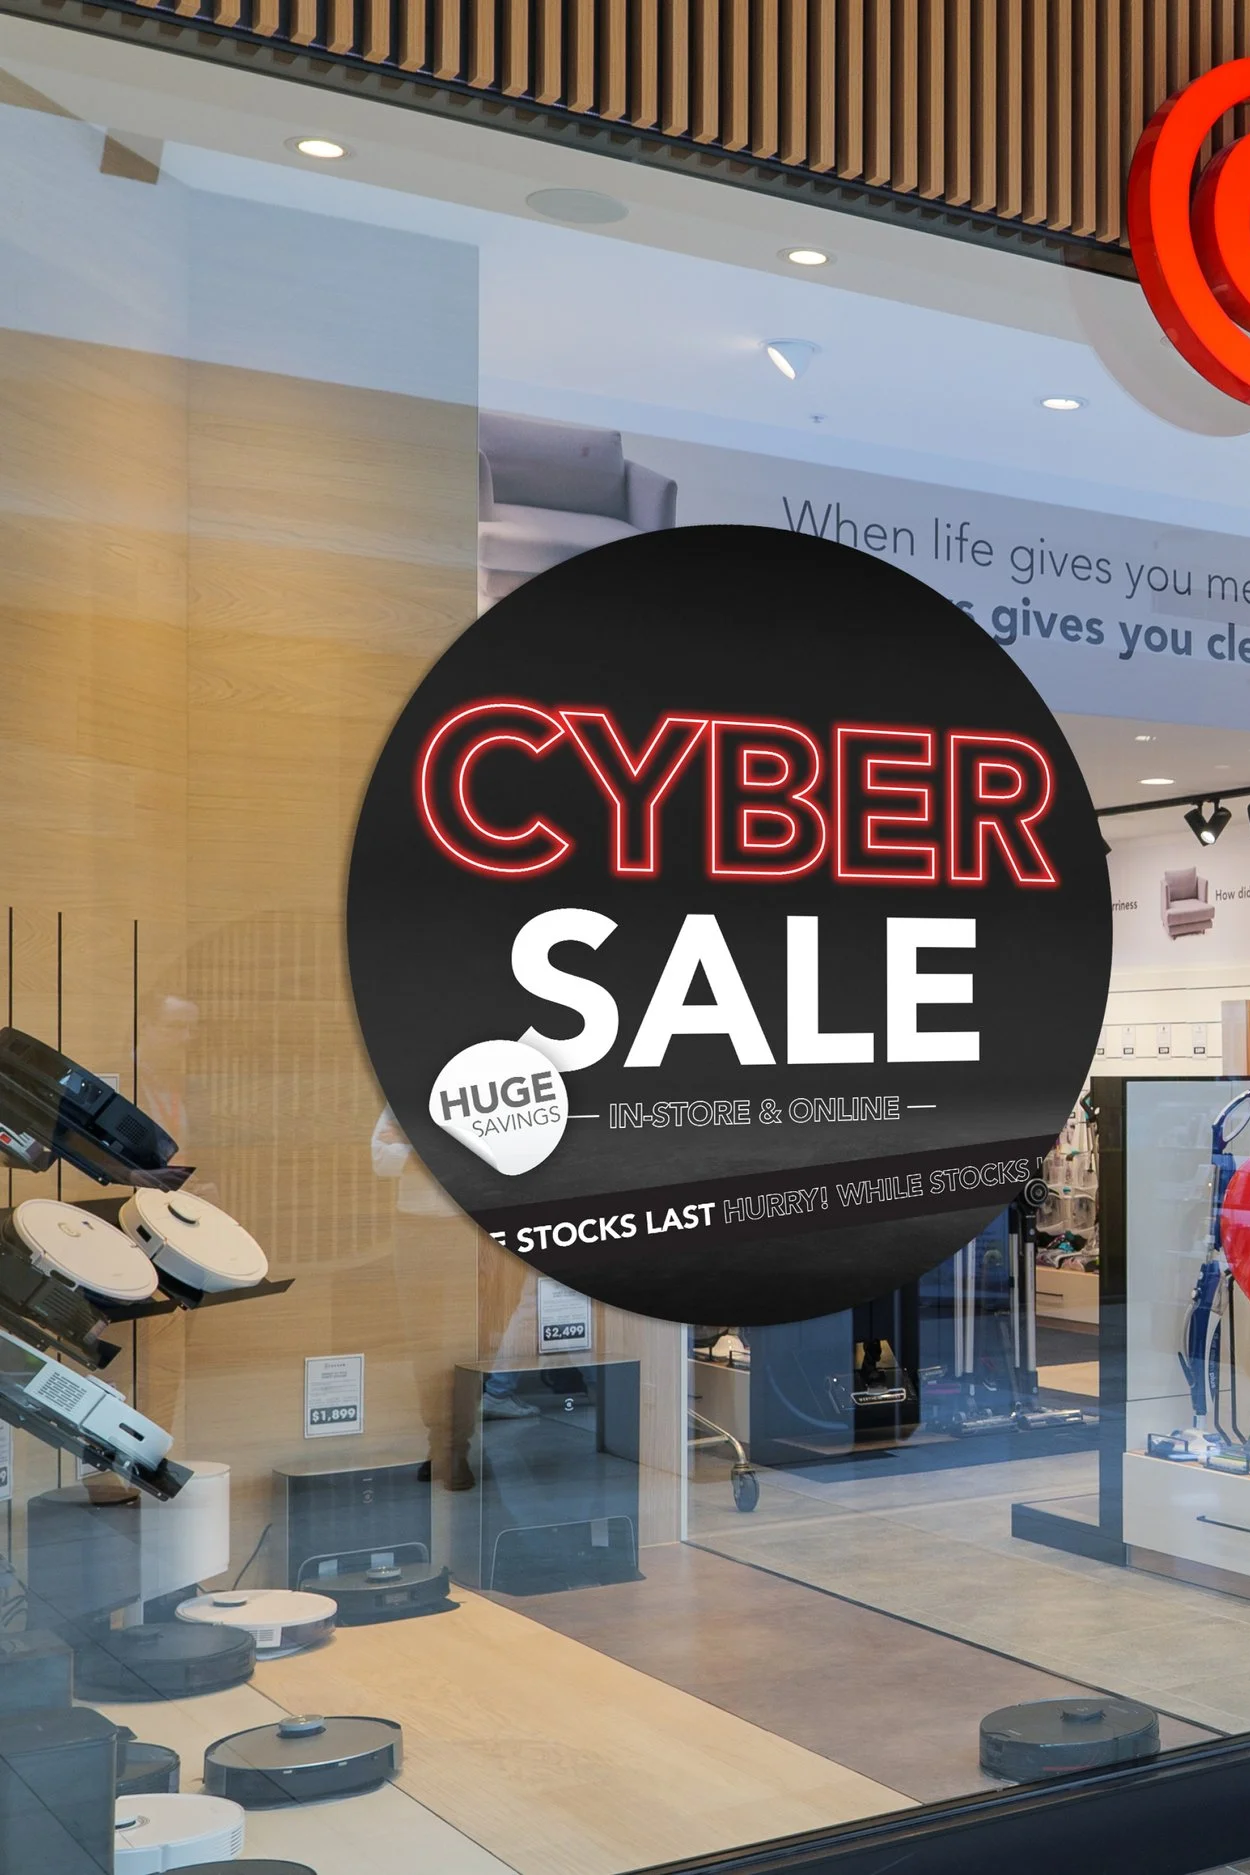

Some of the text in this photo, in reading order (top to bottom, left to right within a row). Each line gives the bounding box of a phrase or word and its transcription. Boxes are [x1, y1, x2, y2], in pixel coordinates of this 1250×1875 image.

[782, 496, 915, 556] When
[934, 517, 994, 567] life
[1010, 538, 1112, 584] gives
[1125, 561, 1192, 600] you
[991, 597, 1105, 646] gives
[1119, 620, 1192, 660] you
[417, 699, 1058, 884] CYBER
[1111, 899, 1138, 912] rriness
[1215, 889, 1235, 902] How
[511, 907, 981, 1073] SALE
[439, 1071, 557, 1121] HUGE
[609, 1095, 900, 1129] IN-STORE & ONLINE
[472, 1105, 561, 1138] SAVINGS
[516, 1213, 637, 1253] STOCKS
[646, 1202, 715, 1235] LAST
[723, 1186, 829, 1224] HURRY!
[836, 1173, 924, 1207] WHILE
[929, 1158, 1030, 1195] STOCKS
[545, 1325, 584, 1339] $2,499
[311, 1407, 356, 1422] $1,899
